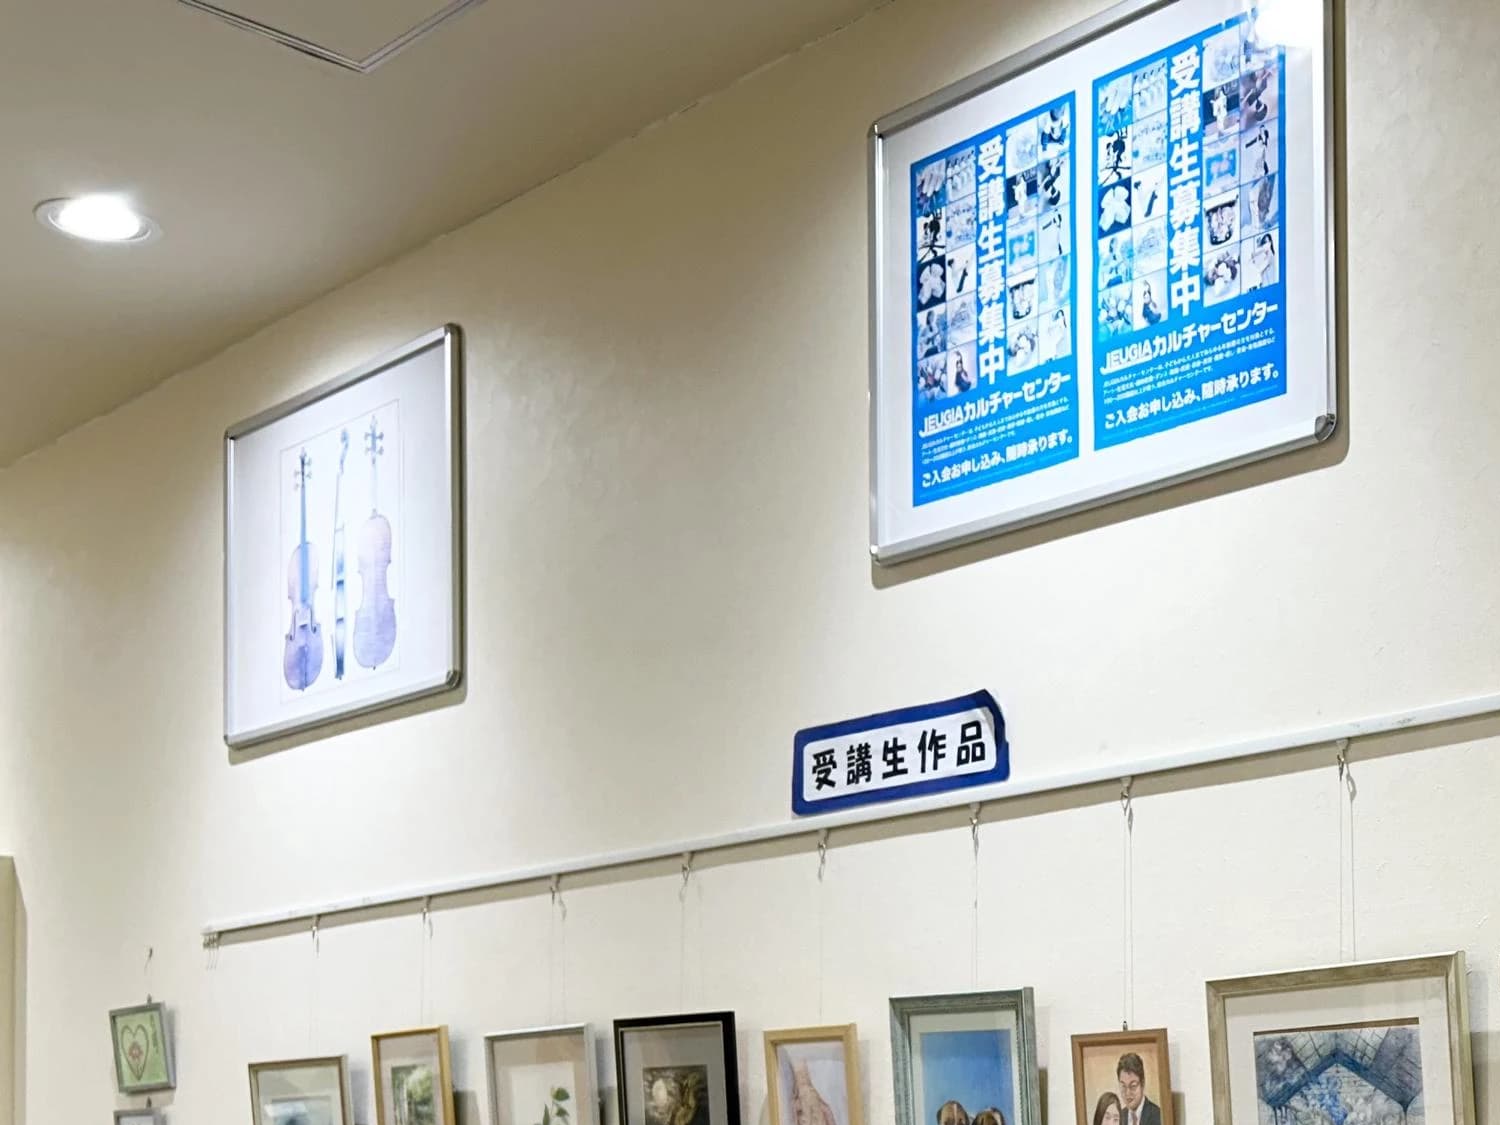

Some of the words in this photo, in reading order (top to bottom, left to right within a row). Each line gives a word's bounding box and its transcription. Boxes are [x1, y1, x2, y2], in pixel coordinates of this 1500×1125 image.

[1168, 44, 1203, 318] 受講生募集中
[977, 135, 1006, 385] 受講生募集中
[1099, 300, 1279, 376] JEUGIAカルチャーセンター
[918, 371, 1071, 438] JEUGIAカルチャーセンター
[1104, 362, 1280, 430] ご入会お申し込み、随時承ります。
[921, 428, 1073, 488] ご入会お申し込み、随時承ります。
[811, 719, 987, 792] 受講生作品
